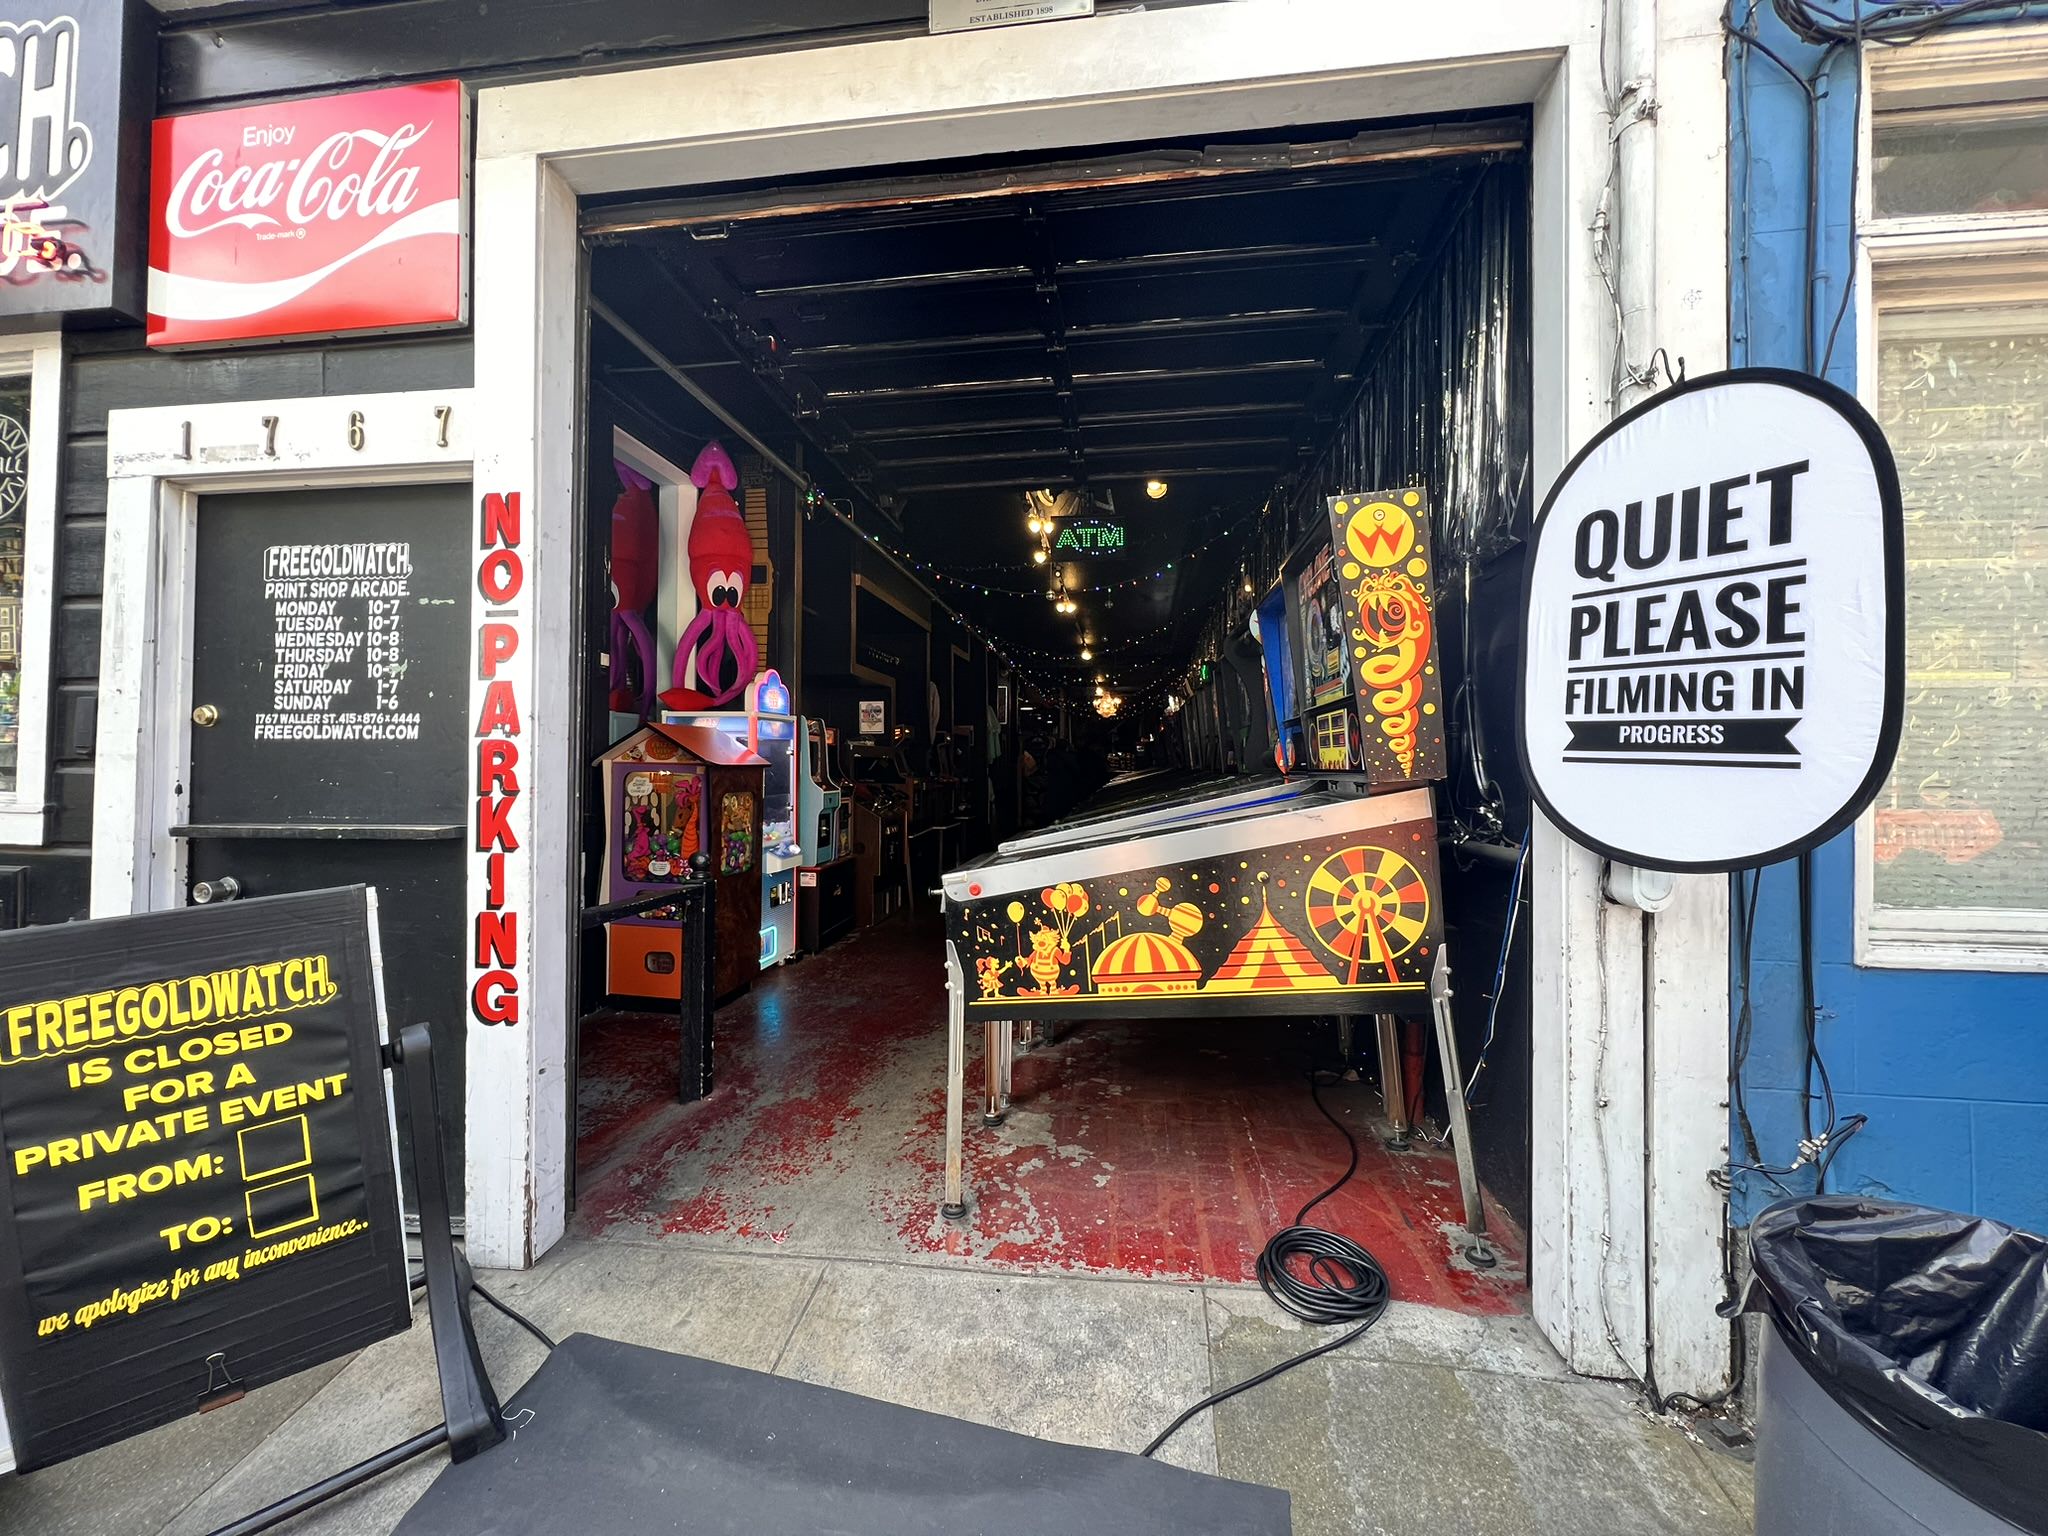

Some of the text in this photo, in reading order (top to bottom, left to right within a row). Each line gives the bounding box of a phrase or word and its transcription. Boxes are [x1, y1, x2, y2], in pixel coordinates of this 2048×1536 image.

[969, 8, 1034, 24] ESTABLISHED
[243, 123, 296, 147] Enjoy
[165, 119, 434, 239] Coca-Cola
[1574, 459, 1810, 582] QUIET
[1055, 526, 1124, 549] ATM
[264, 581, 307, 599] PRINT.
[350, 580, 411, 598] ARCADE.
[275, 600, 400, 616] MONDAY 10-7
[1568, 573, 1807, 661] PLEASE
[275, 615, 400, 631] TUESDAY 10-7
[274, 631, 400, 647] WEDNESDAY 10-8
[275, 647, 400, 663] THURSDAY 10-8
[273, 664, 327, 679] FRIDAY
[273, 679, 399, 694] SATURDAY 1-7
[1565, 665, 1805, 715] FILMING IN
[273, 695, 399, 710] SUNDAY 1-6
[255, 713, 278, 725] 1767
[279, 713, 320, 725] WALLER
[254, 724, 420, 741] FREEGOLDWATCH.COM
[1618, 724, 1725, 745] PROGRESS
[67, 1022, 293, 1089] IS CLOSED
[123, 1062, 257, 1112] FOR A
[14, 1073, 348, 1175] PRIVATE EVENT
[78, 1154, 225, 1212] FROM:
[160, 1216, 233, 1251] TO:
[37, 1311, 70, 1337] we
[74, 1280, 170, 1329] apologize
[170, 1268, 200, 1301] for
[203, 1250, 241, 1281] any
